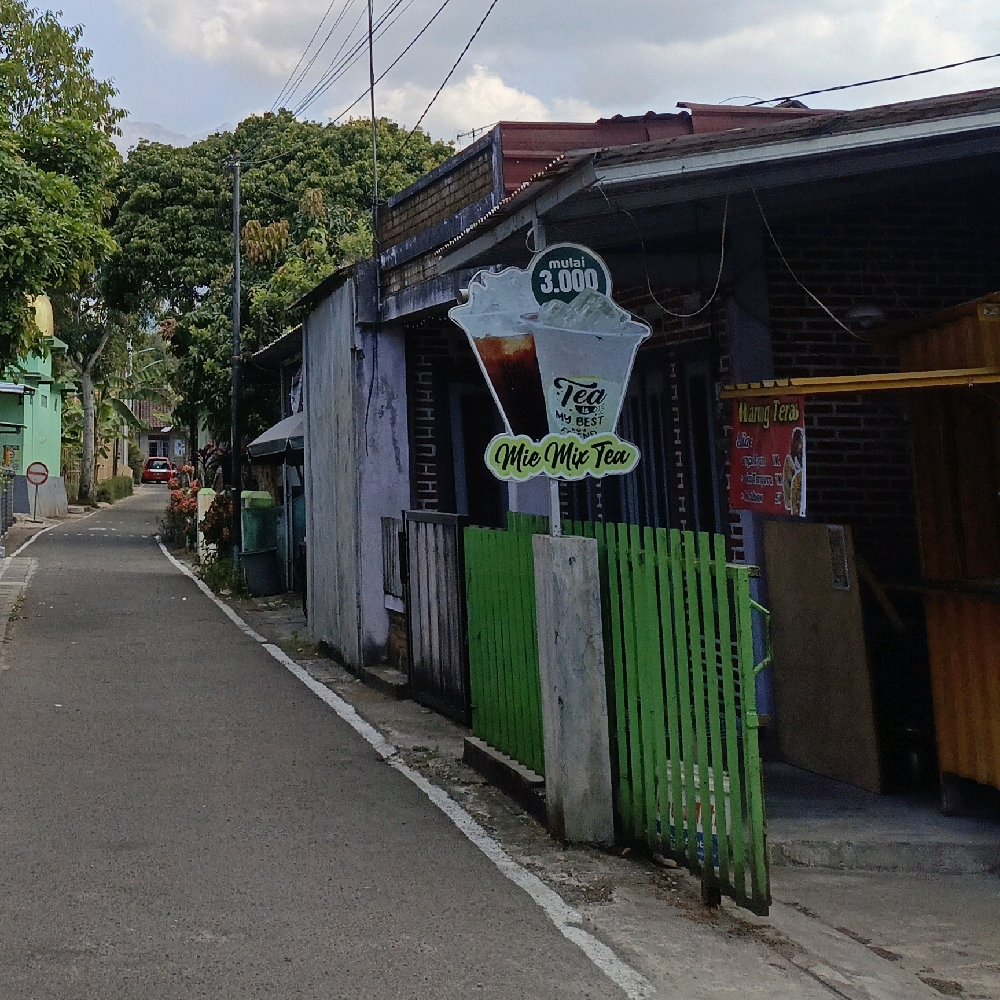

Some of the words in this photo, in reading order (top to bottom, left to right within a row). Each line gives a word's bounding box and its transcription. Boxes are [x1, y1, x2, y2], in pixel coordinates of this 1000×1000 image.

[548, 256, 585, 269] mulai
[539, 268, 599, 293] 3.000
[553, 377, 607, 407] Tea
[576, 416, 604, 427] BEST
[494, 442, 541, 473] Mie
[544, 441, 590, 471] Mix
[590, 440, 630, 469] Tea
